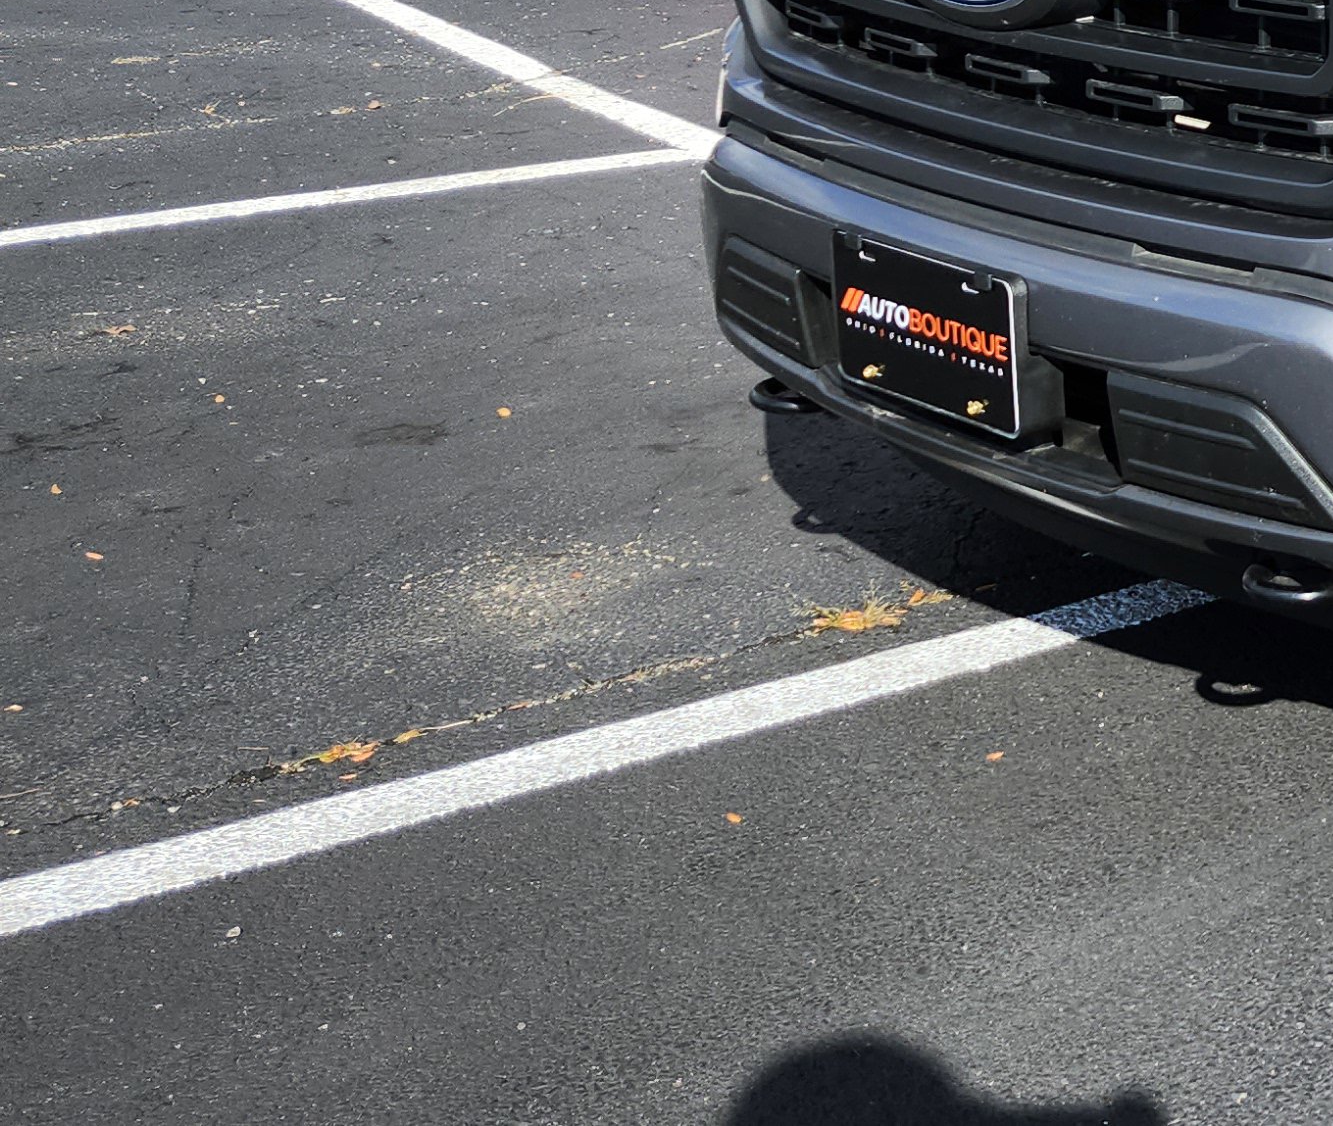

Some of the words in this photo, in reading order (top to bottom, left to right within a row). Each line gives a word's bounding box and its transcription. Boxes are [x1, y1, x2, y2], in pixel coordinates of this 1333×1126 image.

[845, 316, 877, 335] OHIO
[888, 331, 946, 358] FLORIDA
[961, 356, 1004, 377] TEXAS
[858, 293, 1008, 361] AUTOBOUTIQUE
